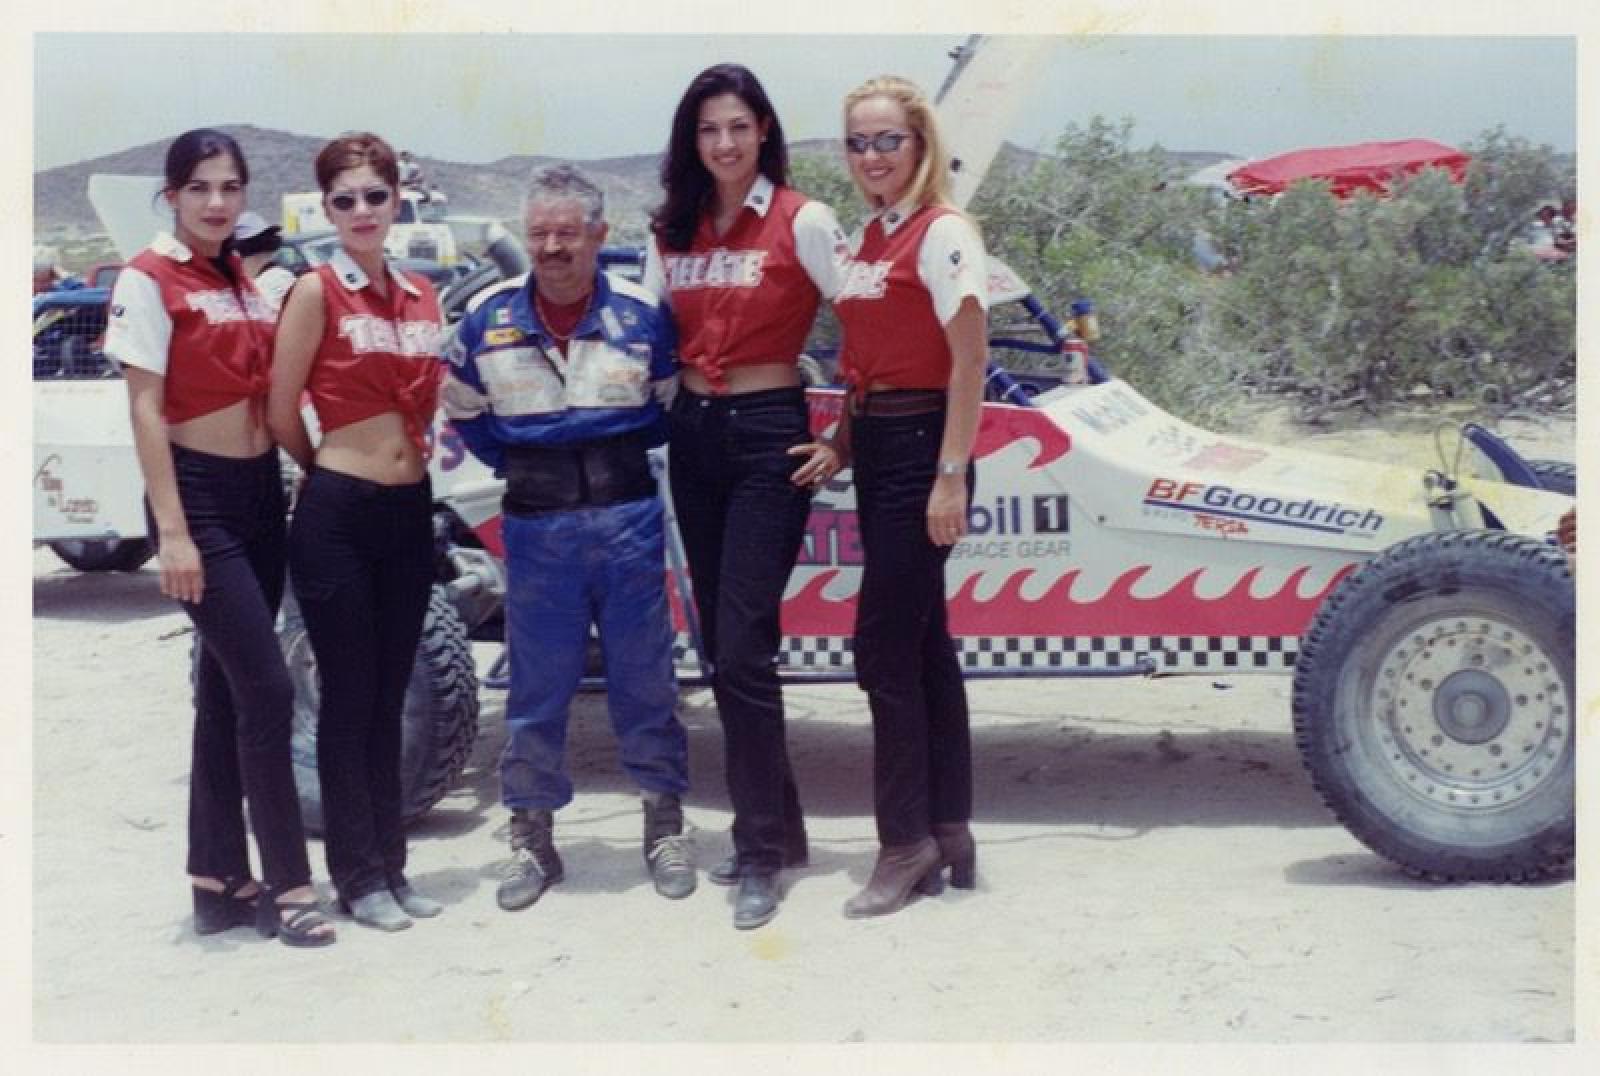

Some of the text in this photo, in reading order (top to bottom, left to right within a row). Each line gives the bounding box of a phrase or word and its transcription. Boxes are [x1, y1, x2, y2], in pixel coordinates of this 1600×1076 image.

[967, 495, 1022, 535] bil
[1145, 478, 1385, 531] BFGoodrich
[1017, 540, 1071, 558] GEAR
